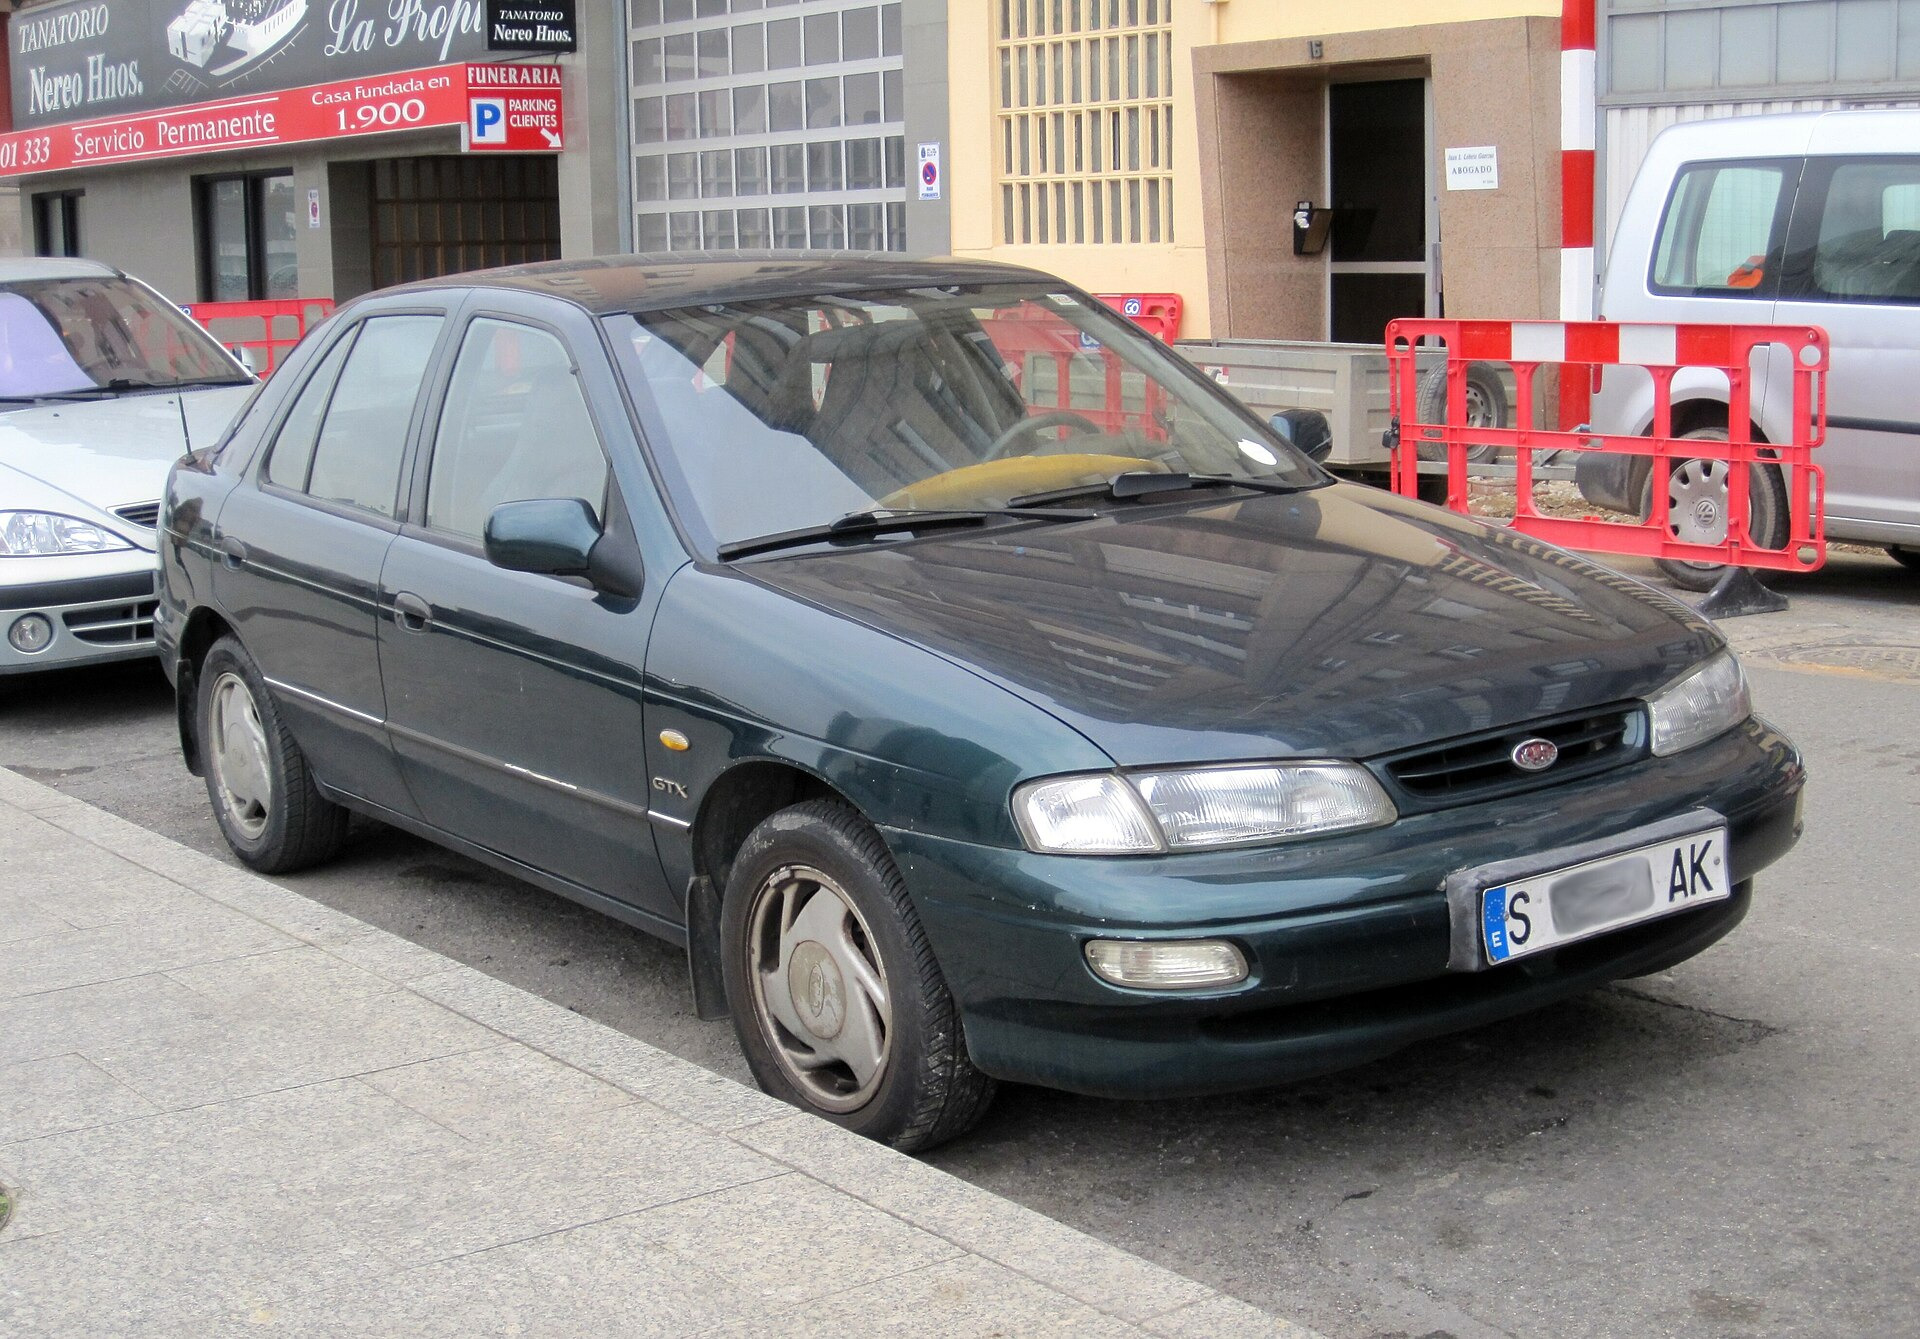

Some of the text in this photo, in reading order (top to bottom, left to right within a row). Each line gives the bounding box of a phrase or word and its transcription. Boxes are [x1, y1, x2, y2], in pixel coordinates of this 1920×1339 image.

[324, 0, 375, 56] La
[500, 10, 563, 20] TANATORIO
[19, 4, 109, 53] TANATORIO
[494, 24, 572, 42] Nereo Hnos.
[29, 53, 144, 114] Nereo Hnos.
[467, 67, 561, 84] FUNERARIA
[312, 76, 450, 105] Casa Fundada en
[337, 99, 425, 130] 1.900
[509, 99, 556, 111] PARKING
[74, 110, 275, 156] Servicio Permanente
[476, 103, 501, 137] P
[510, 115, 557, 127] CLIENTES
[23, 136, 51, 166] 333
[1452, 166, 1492, 175] ABOGADO
[1124, 301, 1140, 315] GO
[653, 776, 689, 799] GTX
[1509, 890, 1531, 945] S
[1668, 839, 1714, 902] AK
[1491, 931, 1502, 948] E
